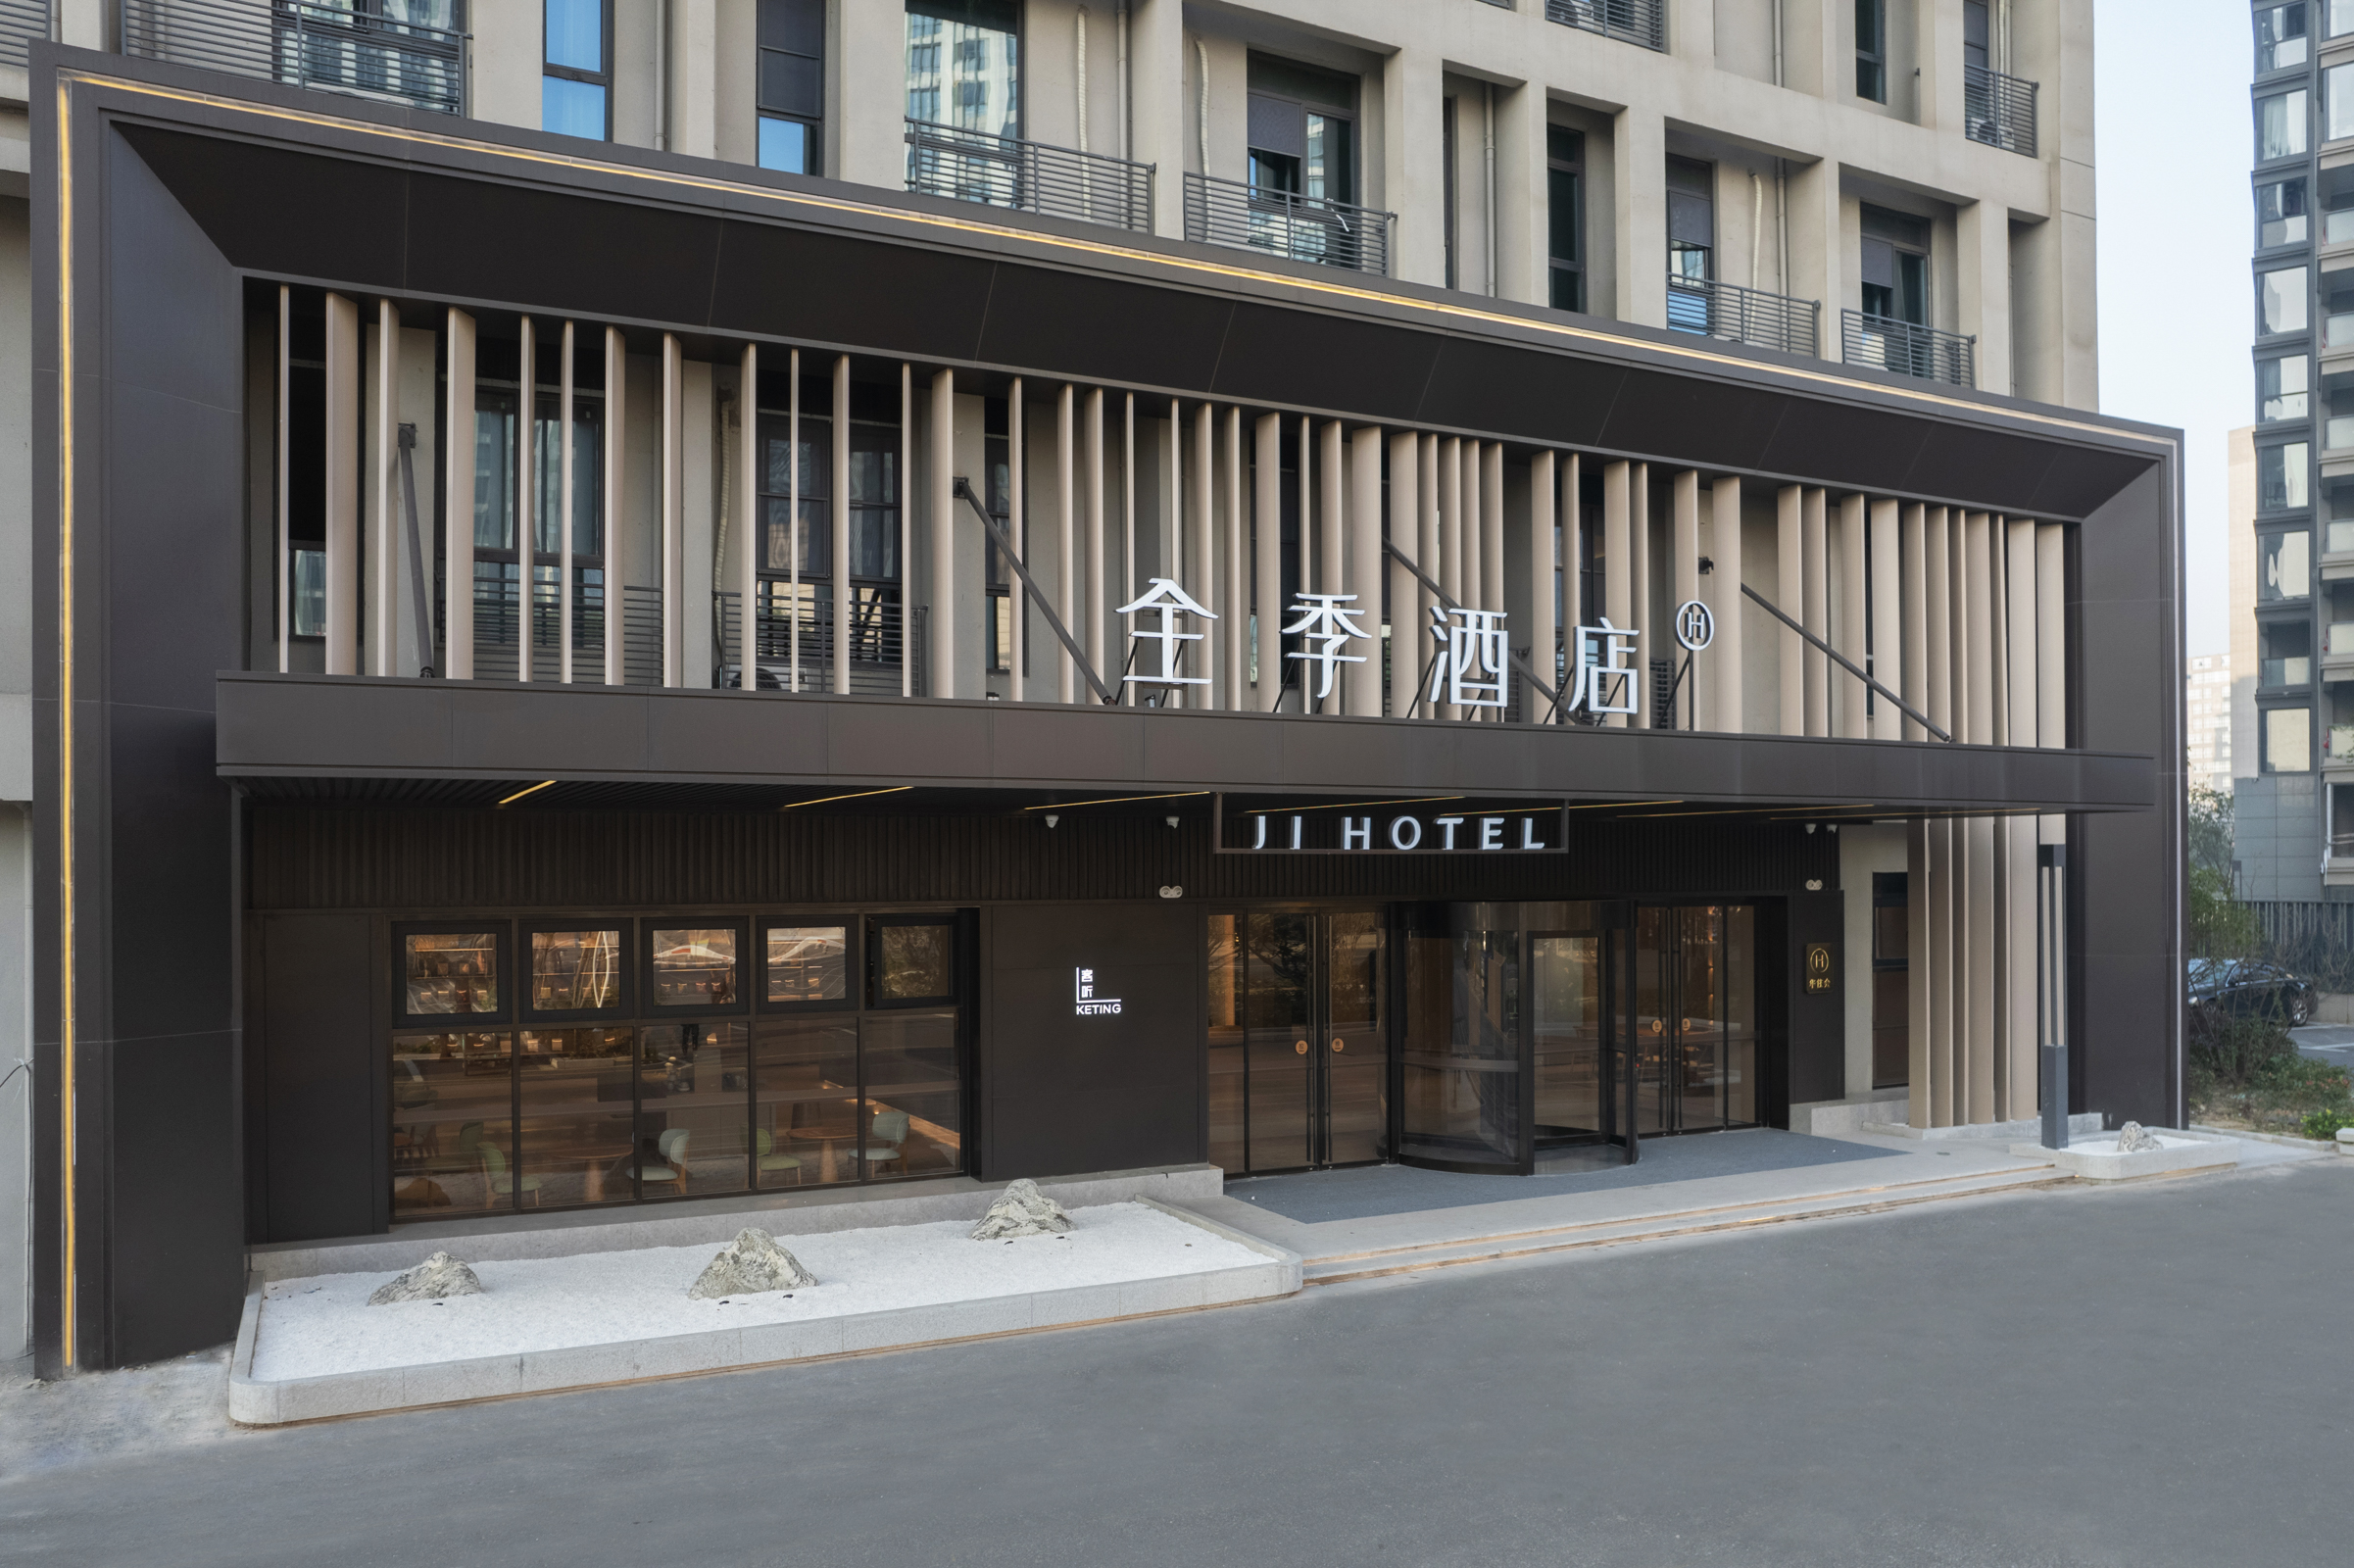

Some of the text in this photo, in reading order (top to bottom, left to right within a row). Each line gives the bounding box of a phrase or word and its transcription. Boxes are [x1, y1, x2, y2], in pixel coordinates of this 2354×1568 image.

[1115, 578, 1640, 713] 全季酒店
[1252, 815, 1545, 851] JI HOTEL
[1076, 1004, 1121, 1015] KETING
